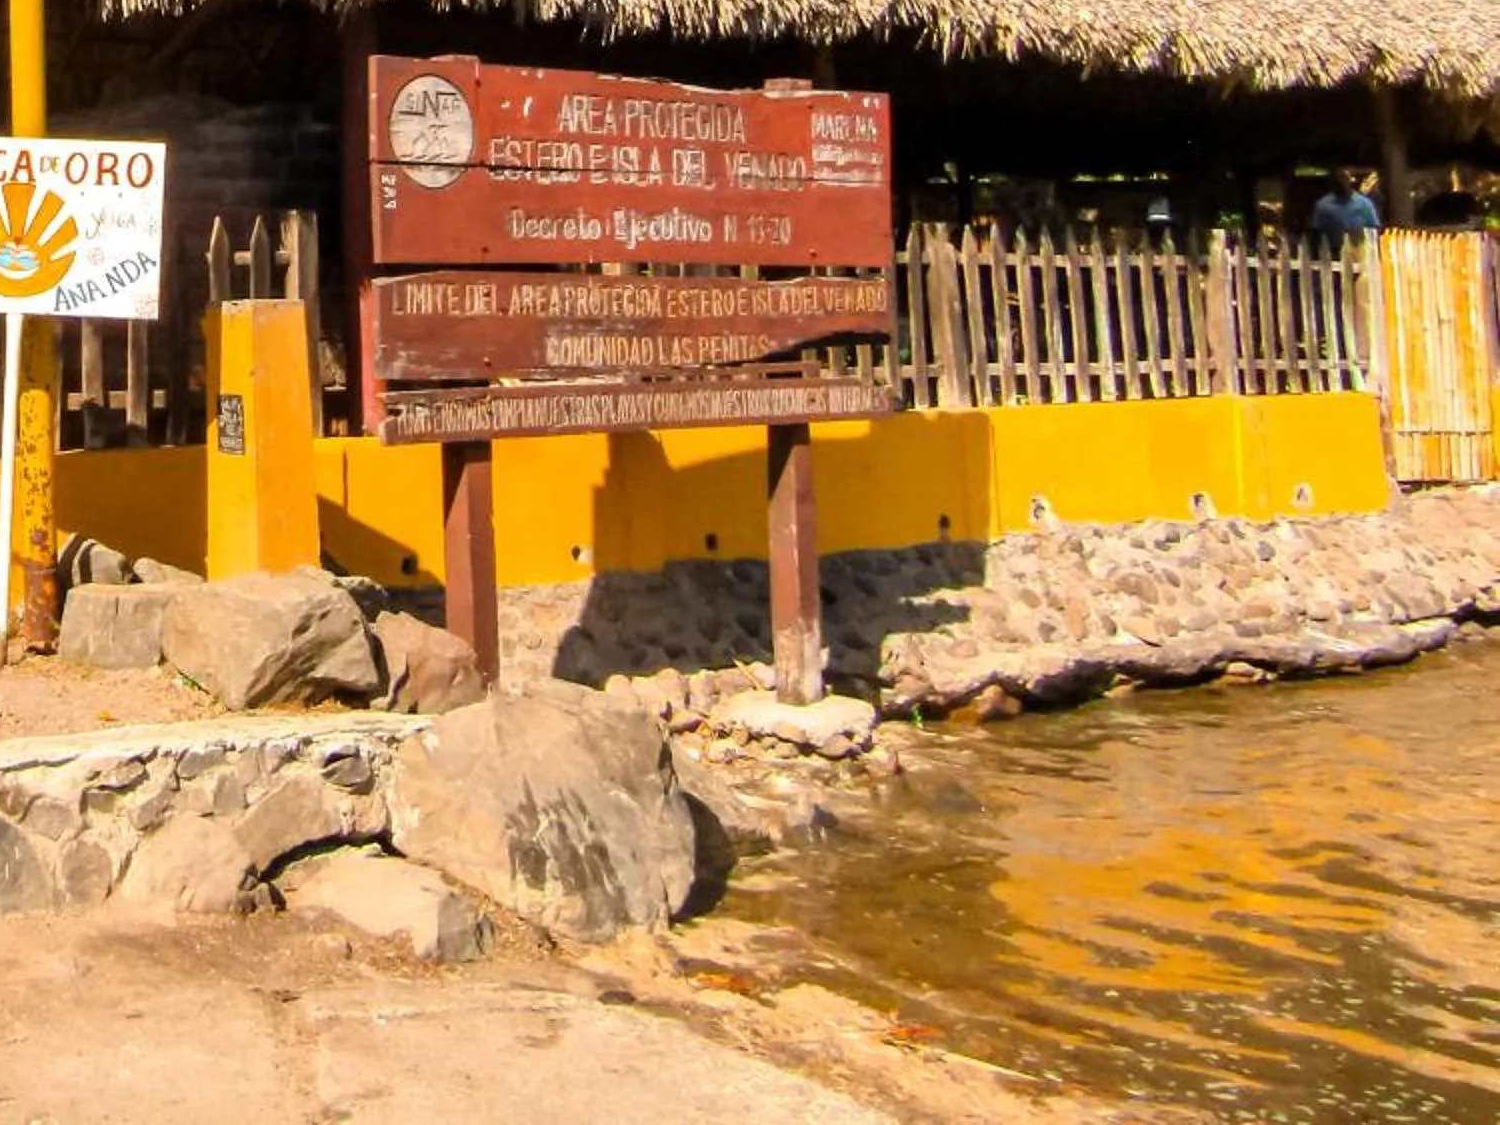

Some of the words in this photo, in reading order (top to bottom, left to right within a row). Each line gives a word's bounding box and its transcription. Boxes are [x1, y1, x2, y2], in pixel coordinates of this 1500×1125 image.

[558, 92, 618, 136] AREA
[622, 98, 747, 146] PROTEGIDA
[40, 155, 61, 174] DE
[64, 151, 154, 189] ORO
[489, 137, 584, 185] ESTERO
[53, 250, 158, 313] ANANDA
[393, 282, 461, 316] LIMITE
[508, 283, 562, 317] AREA
[563, 283, 663, 318] PROTEGIDA
[667, 287, 736, 318] ESTERO
[545, 335, 653, 366] COMUNIDAD
[659, 335, 693, 364] LAS
